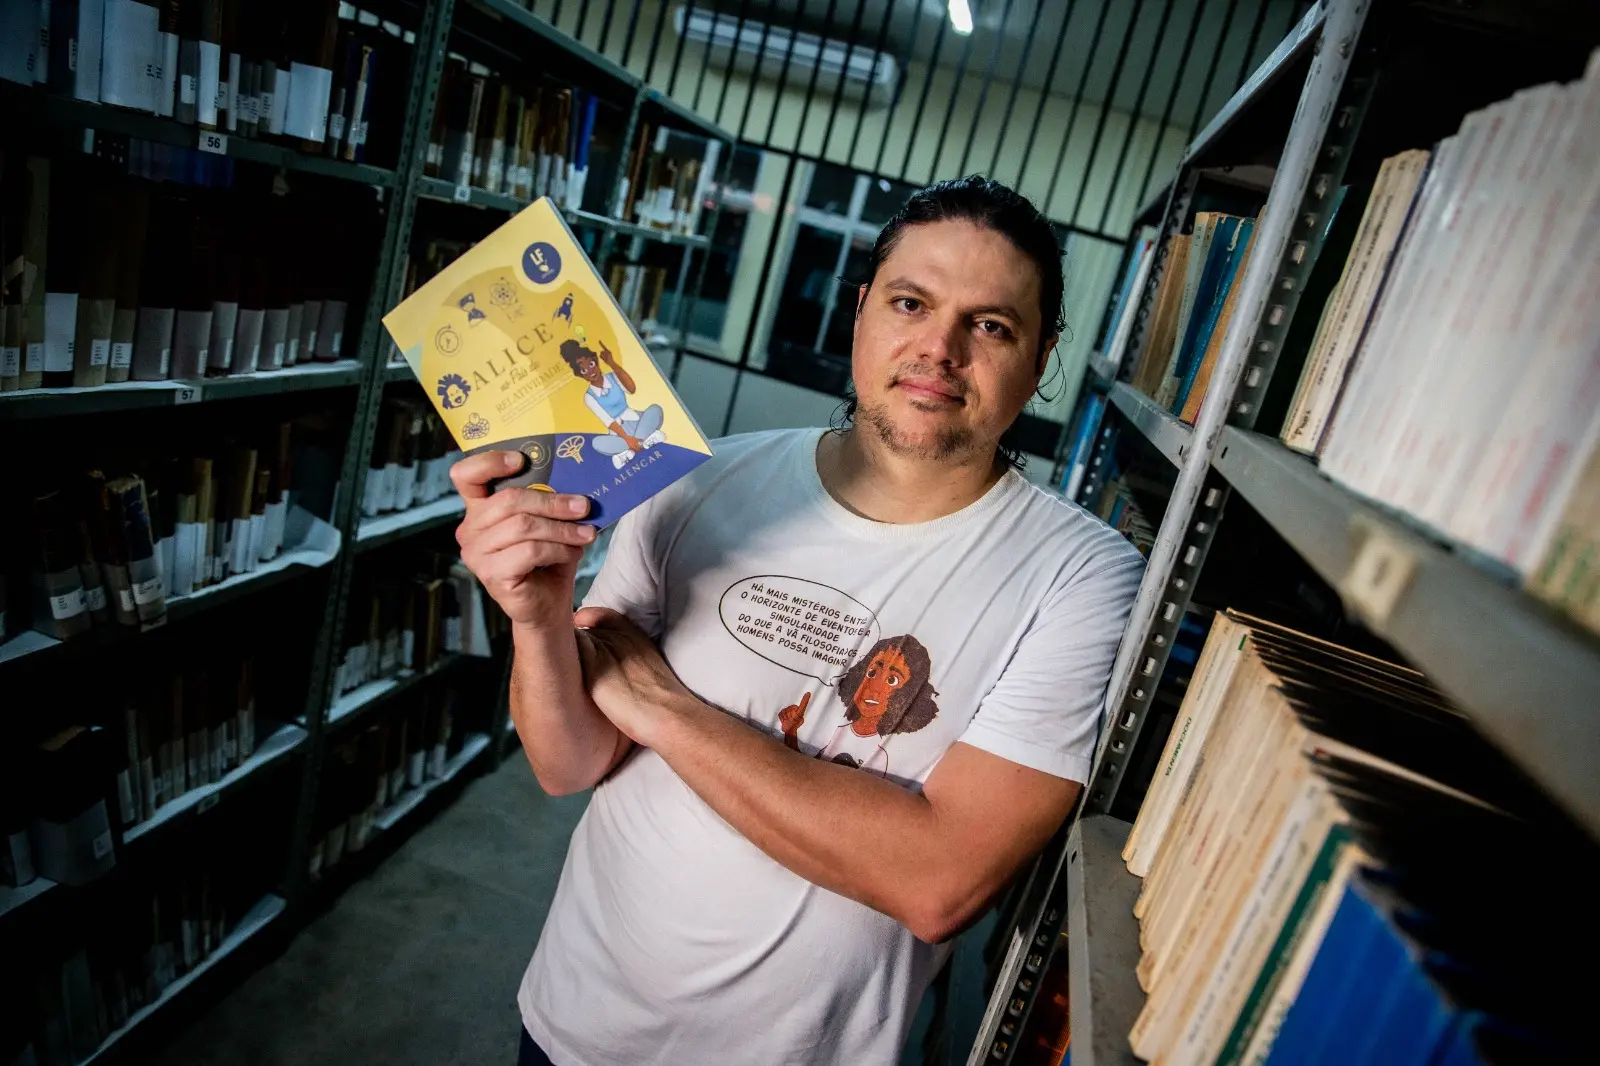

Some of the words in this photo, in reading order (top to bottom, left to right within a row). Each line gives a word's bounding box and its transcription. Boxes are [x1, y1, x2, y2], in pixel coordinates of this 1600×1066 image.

[207, 136, 221, 149] 56
[473, 322, 554, 392] ALICE
[181, 389, 195, 400] 57
[495, 361, 565, 414] RELATIVIDADE
[613, 450, 663, 486] ALENCAR
[740, 591, 748, 599] O
[750, 594, 802, 616] HORIZONTE
[805, 611, 818, 622] DE
[751, 582, 764, 593] HÁ
[766, 587, 789, 601] MAIS
[791, 596, 841, 619] MISTÉRIOS
[843, 614, 868, 626] ENT
[736, 624, 775, 643] HOMENS
[778, 637, 809, 655] POSSA
[738, 613, 751, 623] DO
[754, 618, 773, 629] QUE
[775, 625, 783, 633] A
[786, 628, 799, 639] VÃ
[800, 634, 845, 656] FILOSOFIA
[769, 611, 840, 642] SINGULARIDADE
[1165, 716, 1193, 777] DOCUMENTA
